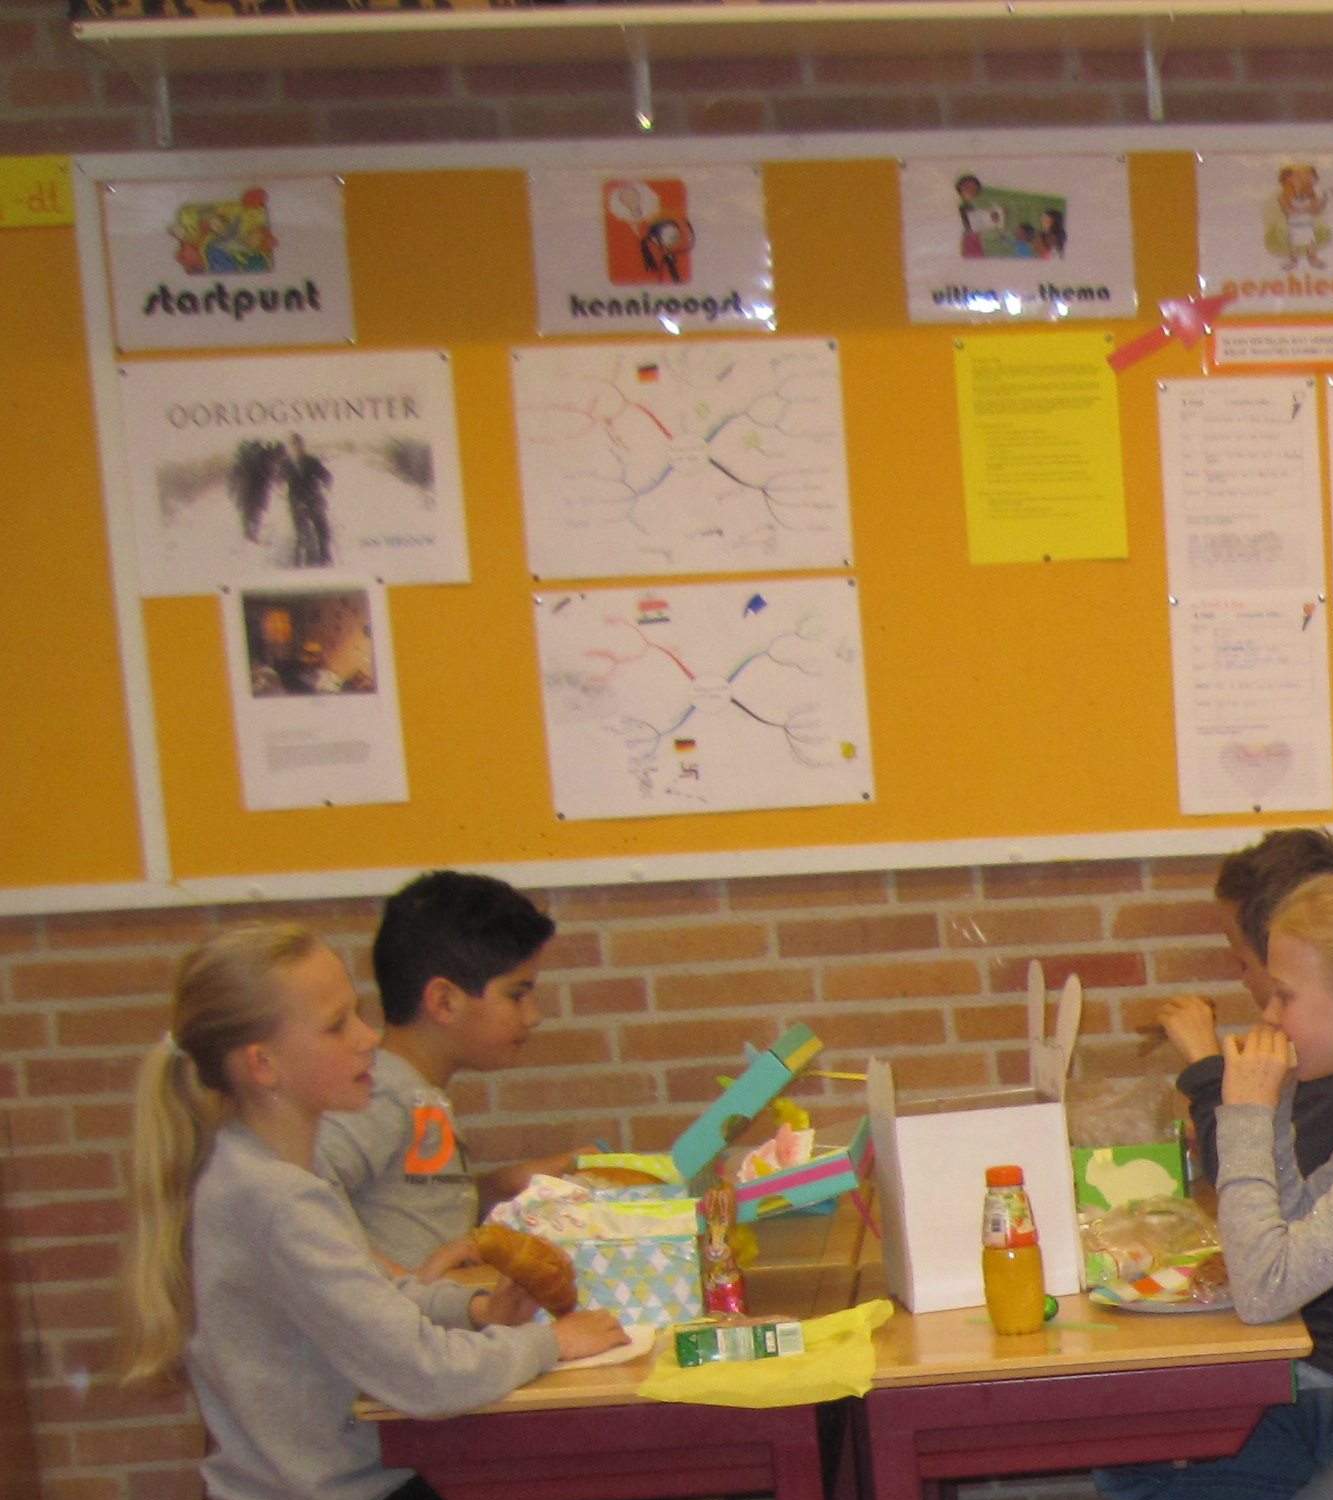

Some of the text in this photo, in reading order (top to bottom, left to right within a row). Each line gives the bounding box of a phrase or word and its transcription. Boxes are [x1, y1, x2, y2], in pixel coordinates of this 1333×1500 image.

[142, 278, 322, 322] startpunt
[569, 290, 745, 321] kennisoogst
[167, 395, 419, 428] OORLOGSWINTER
